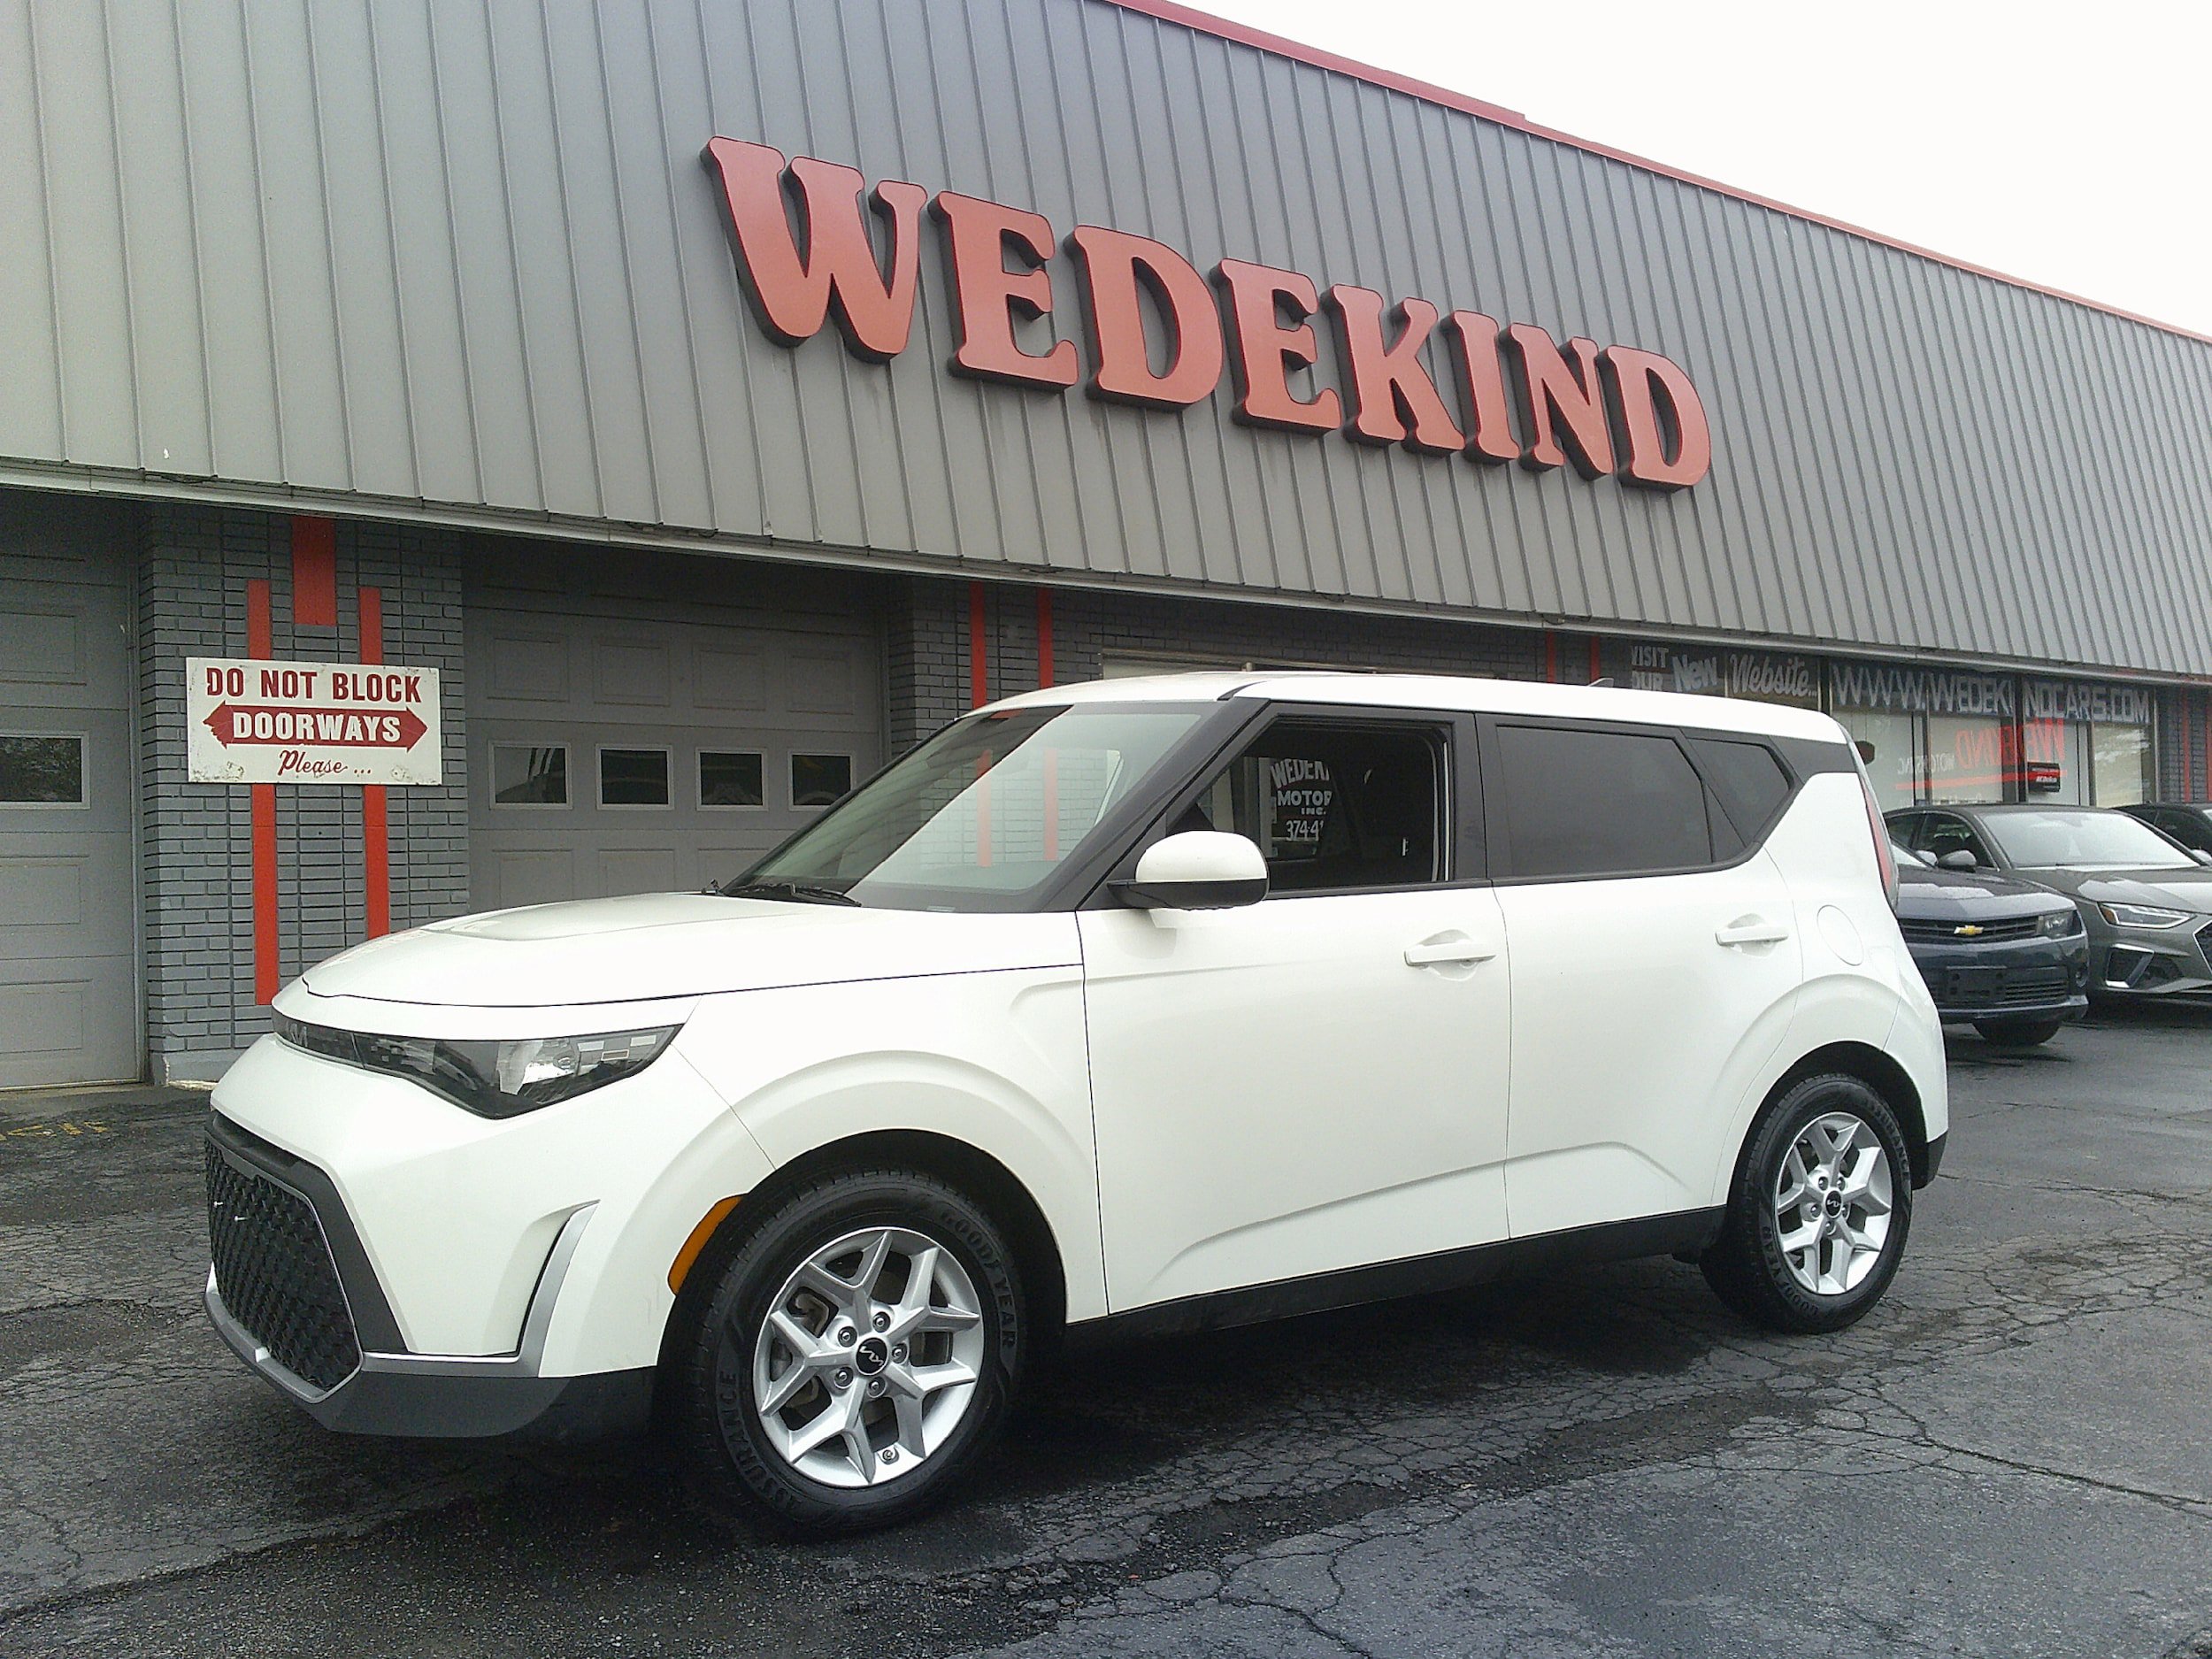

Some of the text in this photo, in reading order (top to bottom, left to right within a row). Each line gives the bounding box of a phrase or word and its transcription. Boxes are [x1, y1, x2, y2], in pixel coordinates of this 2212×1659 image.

[702, 135, 1711, 493] WEDEKIND
[1631, 646, 1669, 668] VISIT
[206, 667, 421, 703] DO NOT BLOCK
[1631, 670, 1663, 691] OUR
[1672, 654, 1719, 692] New
[233, 711, 401, 741] DOORWAYS
[278, 750, 349, 776] Please
